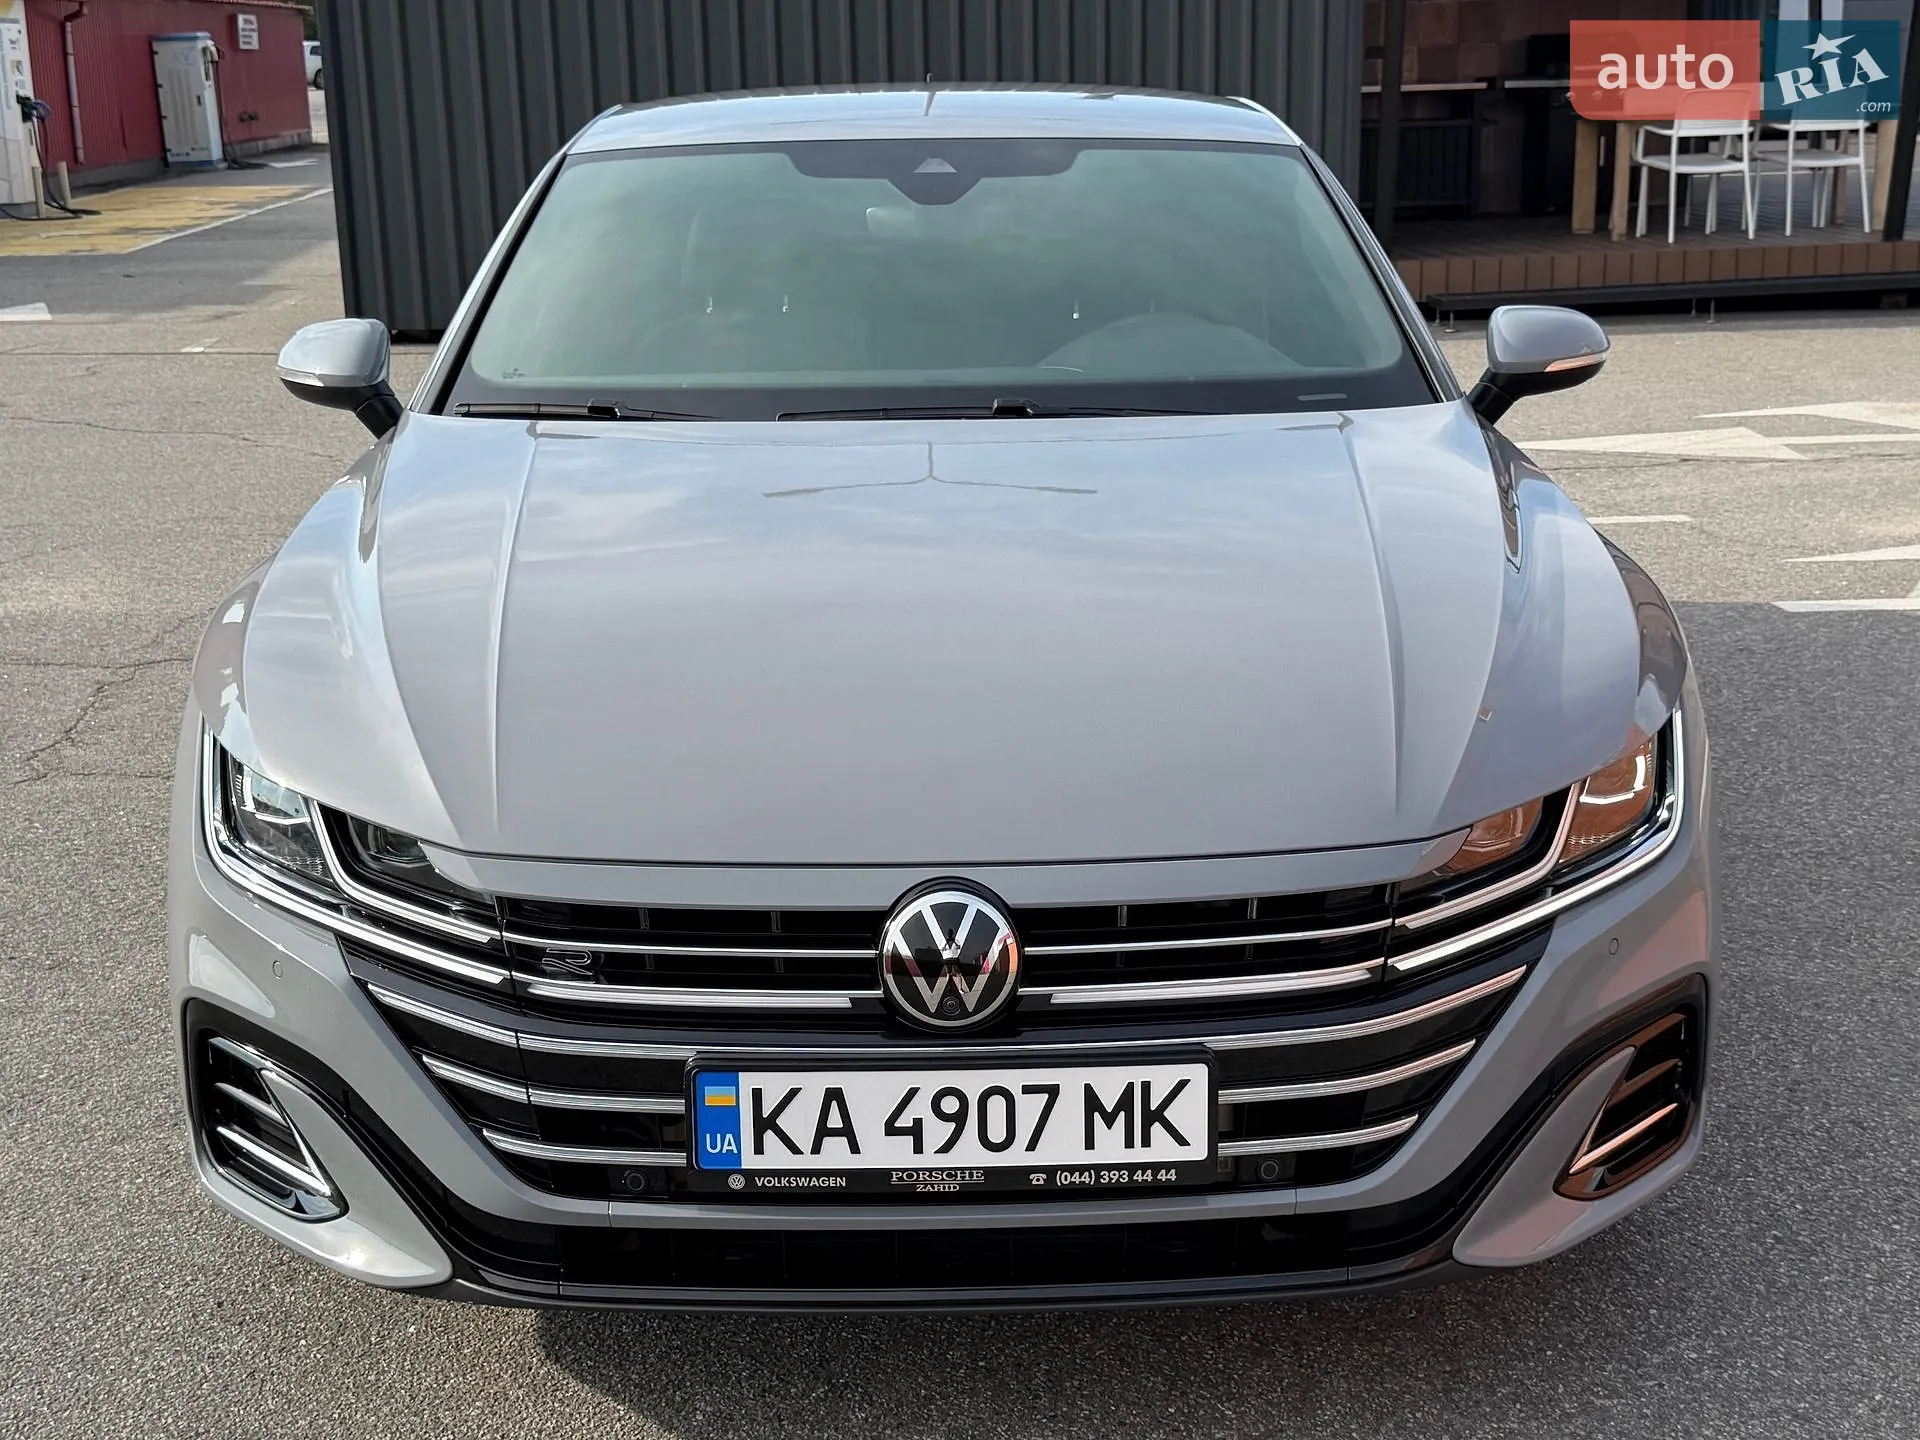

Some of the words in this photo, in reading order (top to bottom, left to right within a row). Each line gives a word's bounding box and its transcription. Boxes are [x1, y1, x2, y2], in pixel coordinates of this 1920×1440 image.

[751, 1086, 861, 1156] KA
[884, 1083, 1060, 1155] 4907
[1083, 1078, 1191, 1151] MK
[705, 1133, 737, 1154] UA
[754, 1176, 846, 1188] VOLKSWAGEN
[890, 1170, 985, 1181] PORSCHE
[1056, 1169, 1095, 1186] (044)
[1100, 1170, 1129, 1183] 393
[1133, 1169, 1153, 1182] 44
[1157, 1168, 1177, 1181] 44
[916, 1184, 960, 1192] ZAHID
